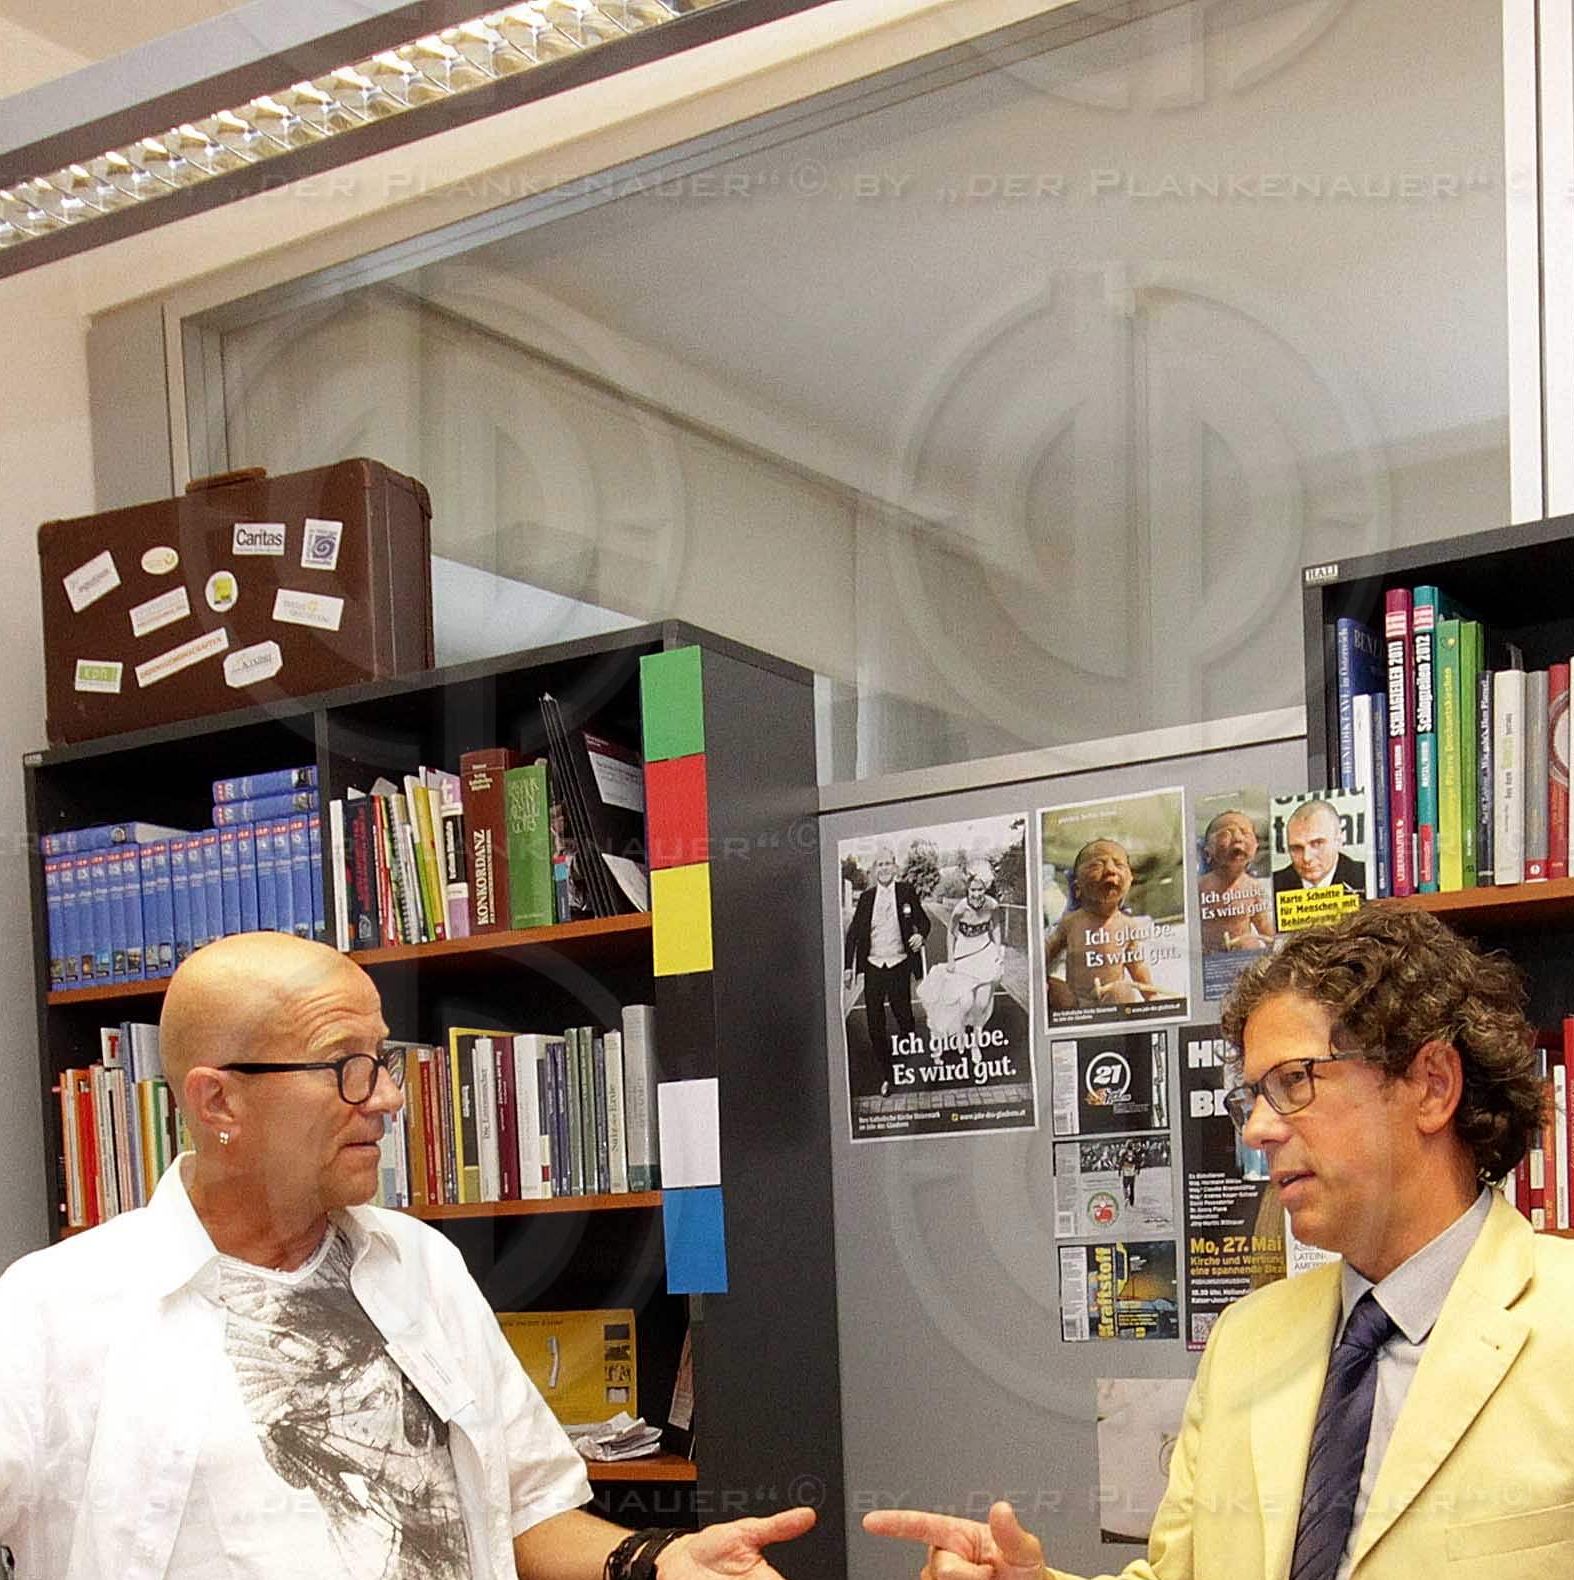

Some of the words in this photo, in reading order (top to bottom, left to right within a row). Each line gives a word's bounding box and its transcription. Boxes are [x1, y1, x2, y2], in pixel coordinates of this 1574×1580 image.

[236, 529, 283, 547] Caritas
[1388, 640, 1403, 664] 2011
[1415, 634, 1431, 663] 2012
[1388, 666, 1405, 737] SCHLAGZEILEN
[1415, 664, 1433, 733] Schlagzeilen
[473, 829, 490, 925] KONKORDANZ
[1201, 890, 1220, 905] Ich
[1306, 889, 1341, 901] Schnitte
[1202, 906, 1215, 920] Es
[1217, 902, 1246, 918] wird
[1280, 904, 1292, 915] für
[1296, 901, 1339, 914] Menschen
[1342, 899, 1357, 908] mit
[1085, 928, 1110, 946] Ich
[1115, 922, 1175, 944] glaube.
[1086, 951, 1105, 968] Es
[1107, 946, 1148, 967] wird
[1149, 945, 1181, 965] gut.
[891, 1032, 924, 1056] Ich
[929, 1026, 1009, 1059] glaube.
[893, 1064, 915, 1086] Es
[919, 1057, 969, 1083] wird
[974, 1055, 1017, 1084] gut.
[1094, 1064, 1122, 1084] 21
[1191, 1238, 1219, 1255] Mo,
[1223, 1236, 1249, 1252] 27.
[1252, 1235, 1282, 1252] Mai
[1293, 1252, 1326, 1261] LATEIN-
[1191, 1256, 1221, 1266] Kirche
[1095, 1247, 1115, 1338] Kraftstoff
